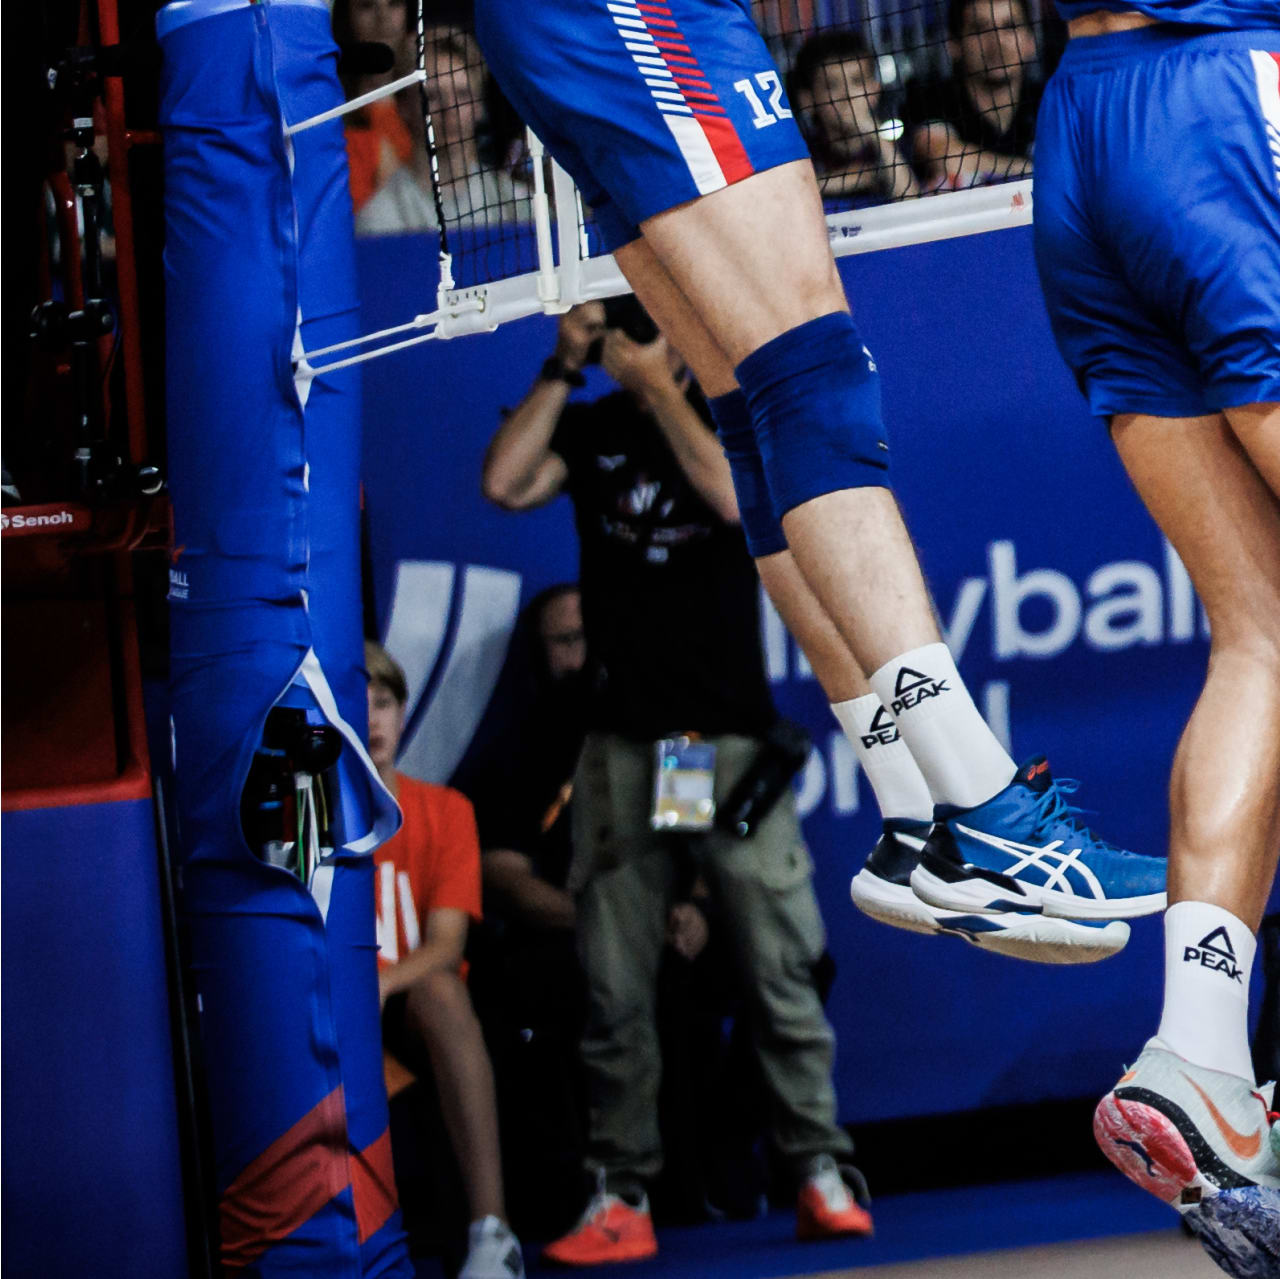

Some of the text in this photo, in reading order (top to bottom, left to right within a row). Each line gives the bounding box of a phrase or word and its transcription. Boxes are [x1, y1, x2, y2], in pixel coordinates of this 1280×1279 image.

[733, 70, 793, 130] 12
[12, 510, 73, 529] Senoh
[890, 678, 951, 718] PEAK
[861, 725, 902, 751] PEA
[1183, 945, 1243, 985] PEAK
